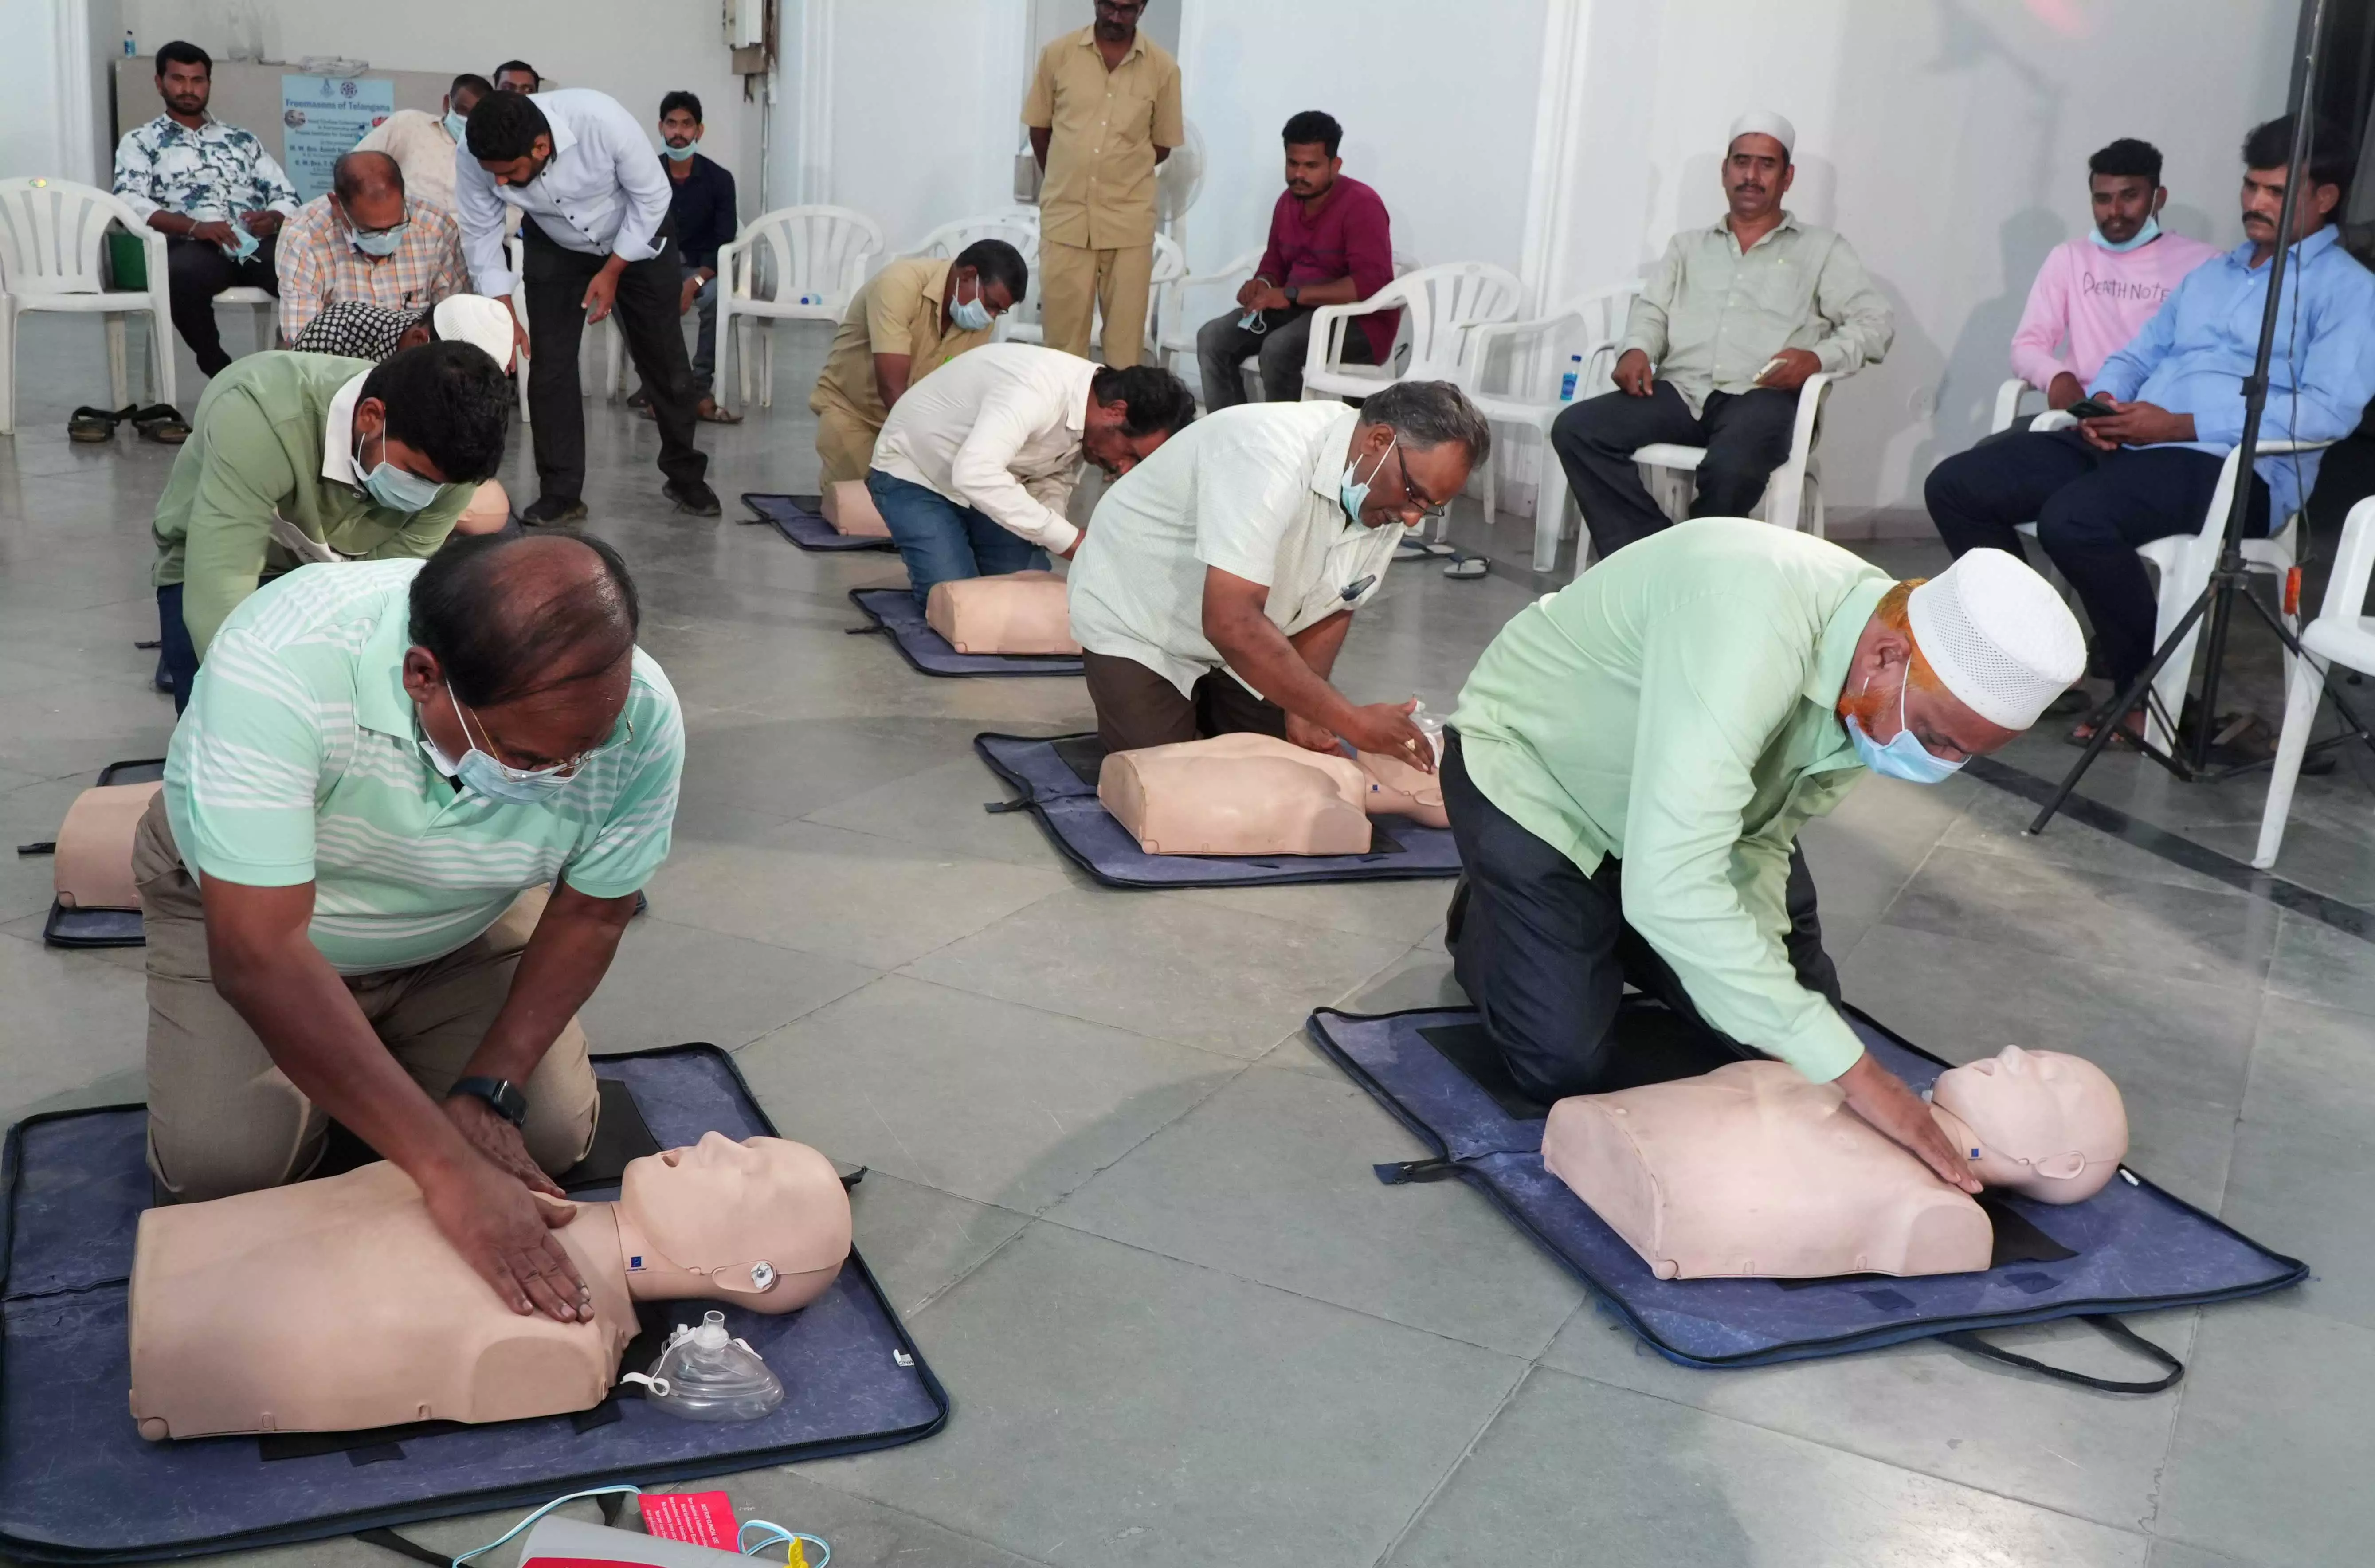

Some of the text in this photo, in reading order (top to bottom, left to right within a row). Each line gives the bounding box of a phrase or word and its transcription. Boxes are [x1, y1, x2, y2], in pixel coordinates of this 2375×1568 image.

[286, 99, 336, 109] Freemasons
[349, 101, 390, 112] Telangana
[2083, 271, 2171, 303] DEATH NOTE
[706, 1519, 717, 1537] CLINICAL
[712, 1536, 721, 1545] USE
